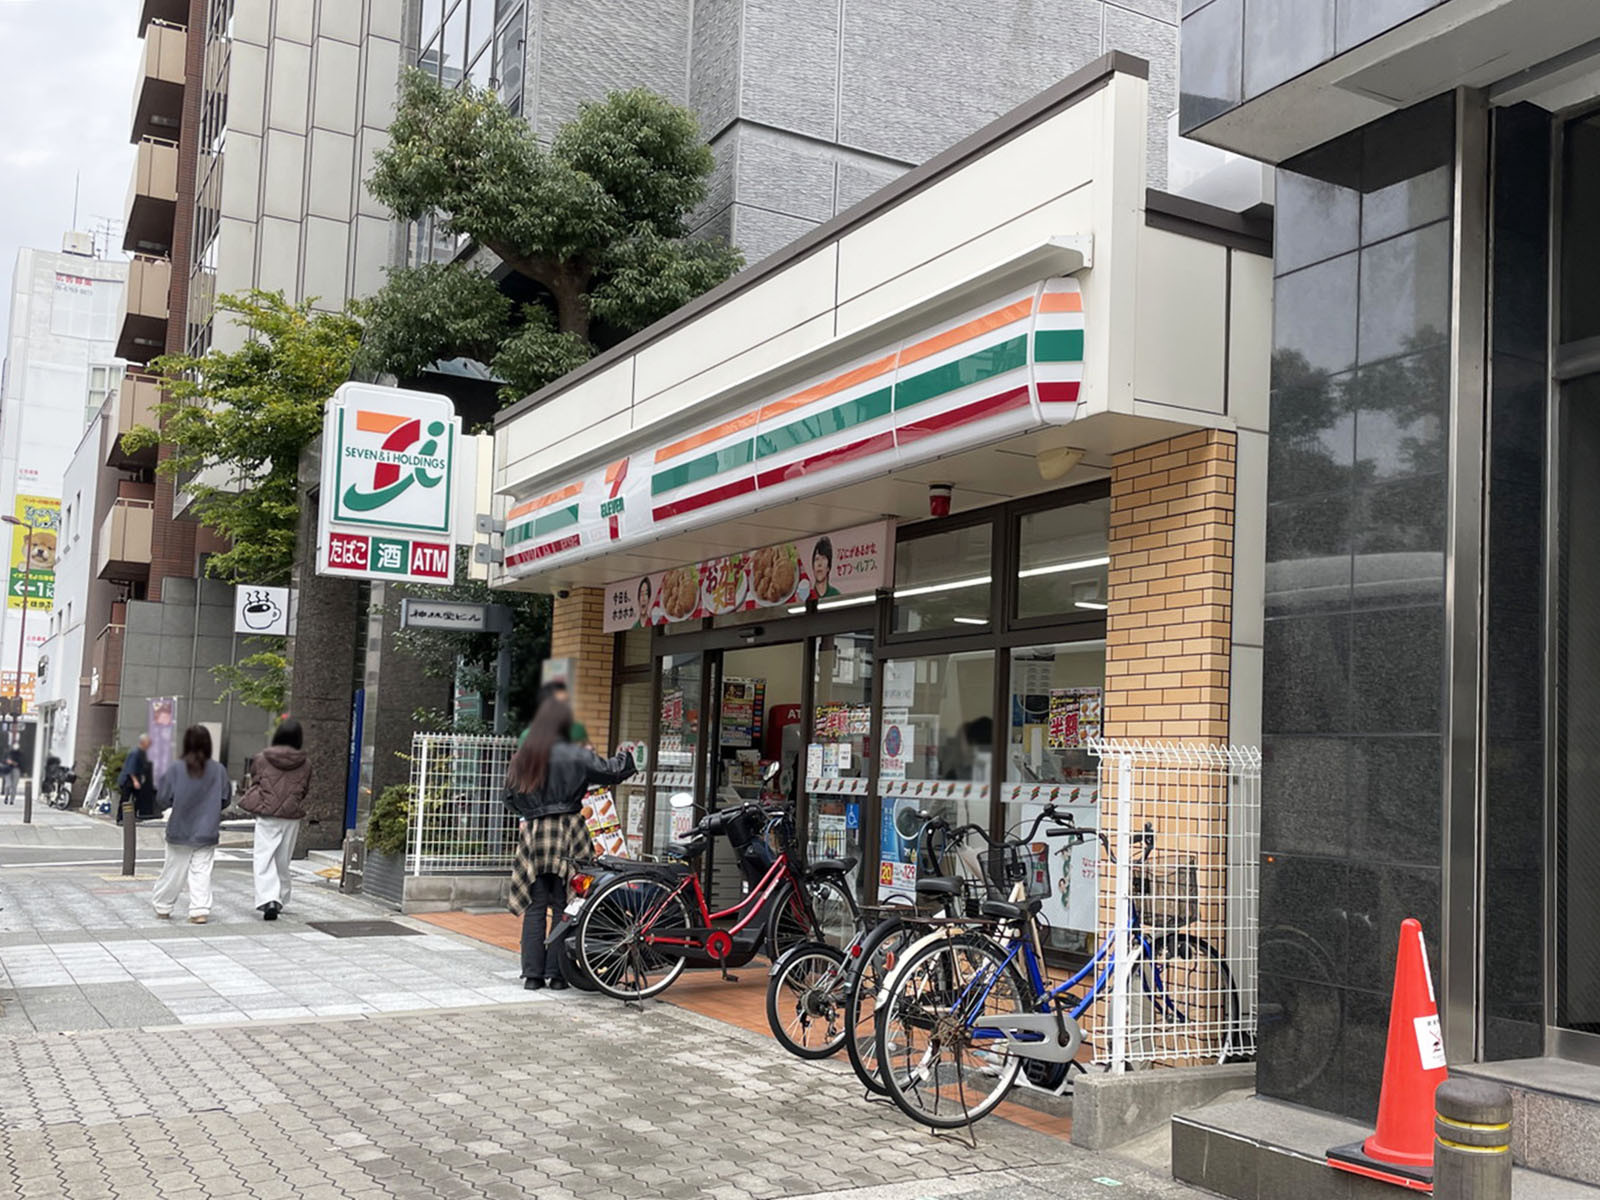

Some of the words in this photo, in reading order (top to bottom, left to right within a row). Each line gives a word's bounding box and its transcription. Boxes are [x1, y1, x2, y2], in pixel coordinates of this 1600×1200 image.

[393, 454, 446, 470] HOLDINGS
[329, 539, 367, 566] たばこ
[377, 543, 403, 569] 酒
[412, 546, 447, 574] ATM
[787, 709, 802, 719] AT
